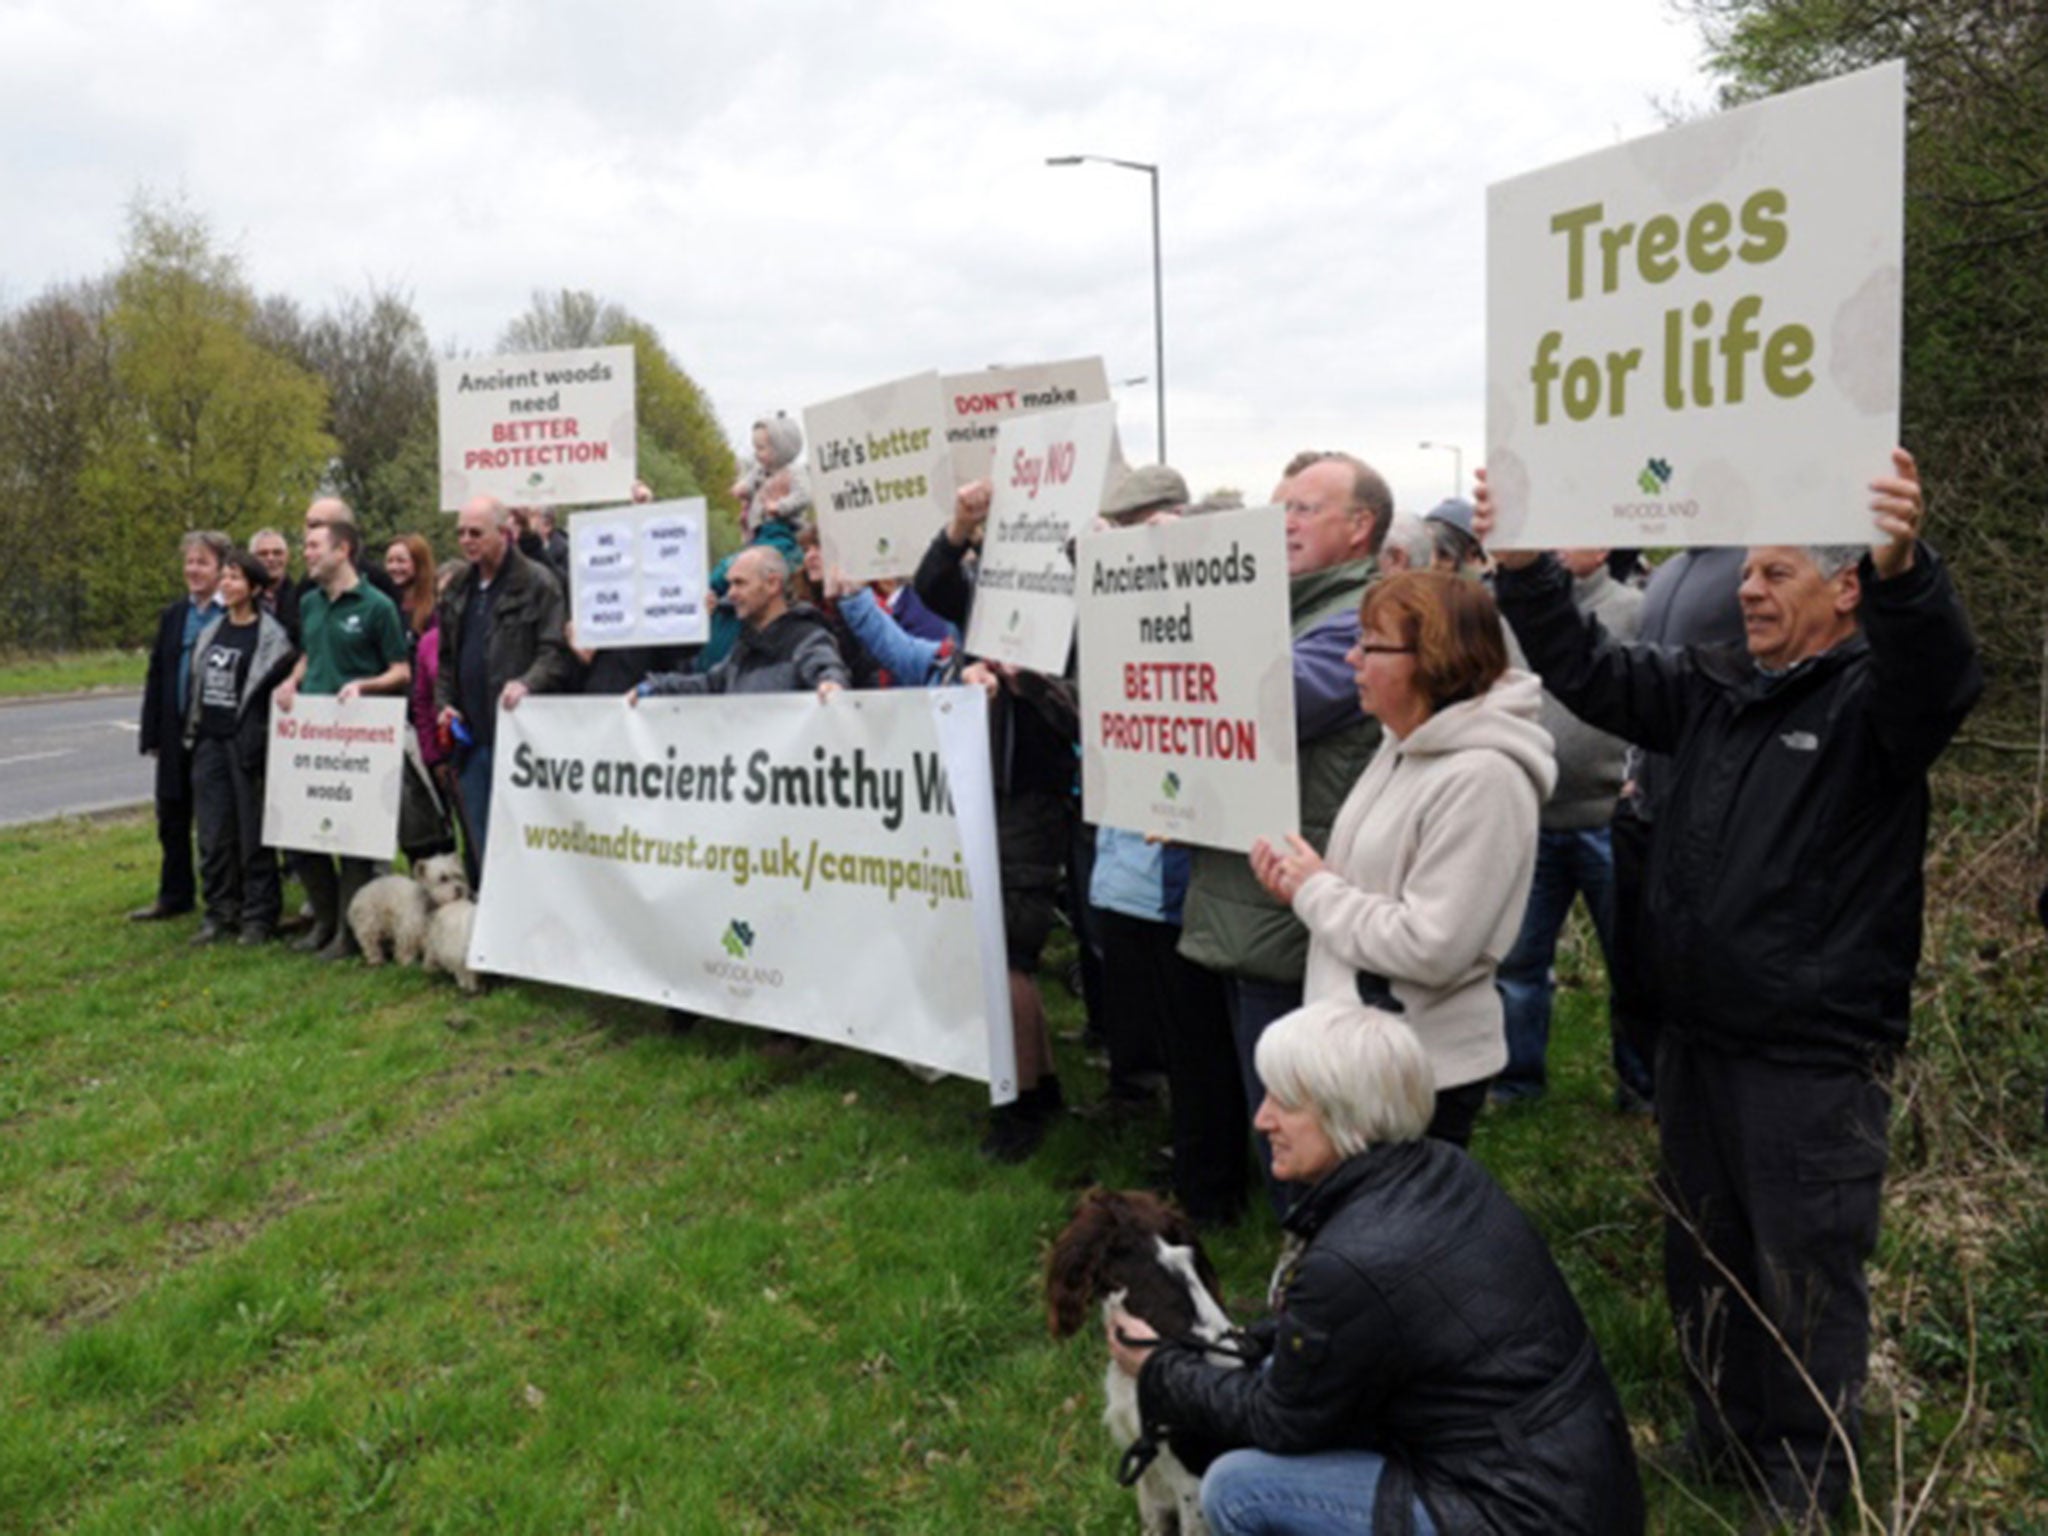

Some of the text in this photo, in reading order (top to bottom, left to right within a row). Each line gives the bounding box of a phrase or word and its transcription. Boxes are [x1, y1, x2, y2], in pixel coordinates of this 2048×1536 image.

[1551, 188, 1788, 301] Trees
[458, 361, 613, 393] Ancient woods
[1531, 295, 1815, 425] for life
[509, 391, 560, 413] need
[954, 386, 1077, 415] DON'T make
[492, 417, 579, 443] BETTER
[464, 441, 608, 469] PROTECTION
[817, 427, 932, 473] Life's better
[1010, 441, 1076, 499] Say NO
[831, 474, 928, 511] with trees
[1093, 541, 1256, 595] Ancient woods
[1139, 602, 1192, 643] need
[1124, 662, 1218, 703] BETTER
[276, 718, 395, 747] NO development
[1100, 712, 1257, 761] PROTECTION
[294, 751, 370, 773] on ancient
[306, 782, 353, 801] woods
[510, 741, 585, 793] Save
[592, 745, 737, 802] ancient
[744, 746, 904, 832] Smithy
